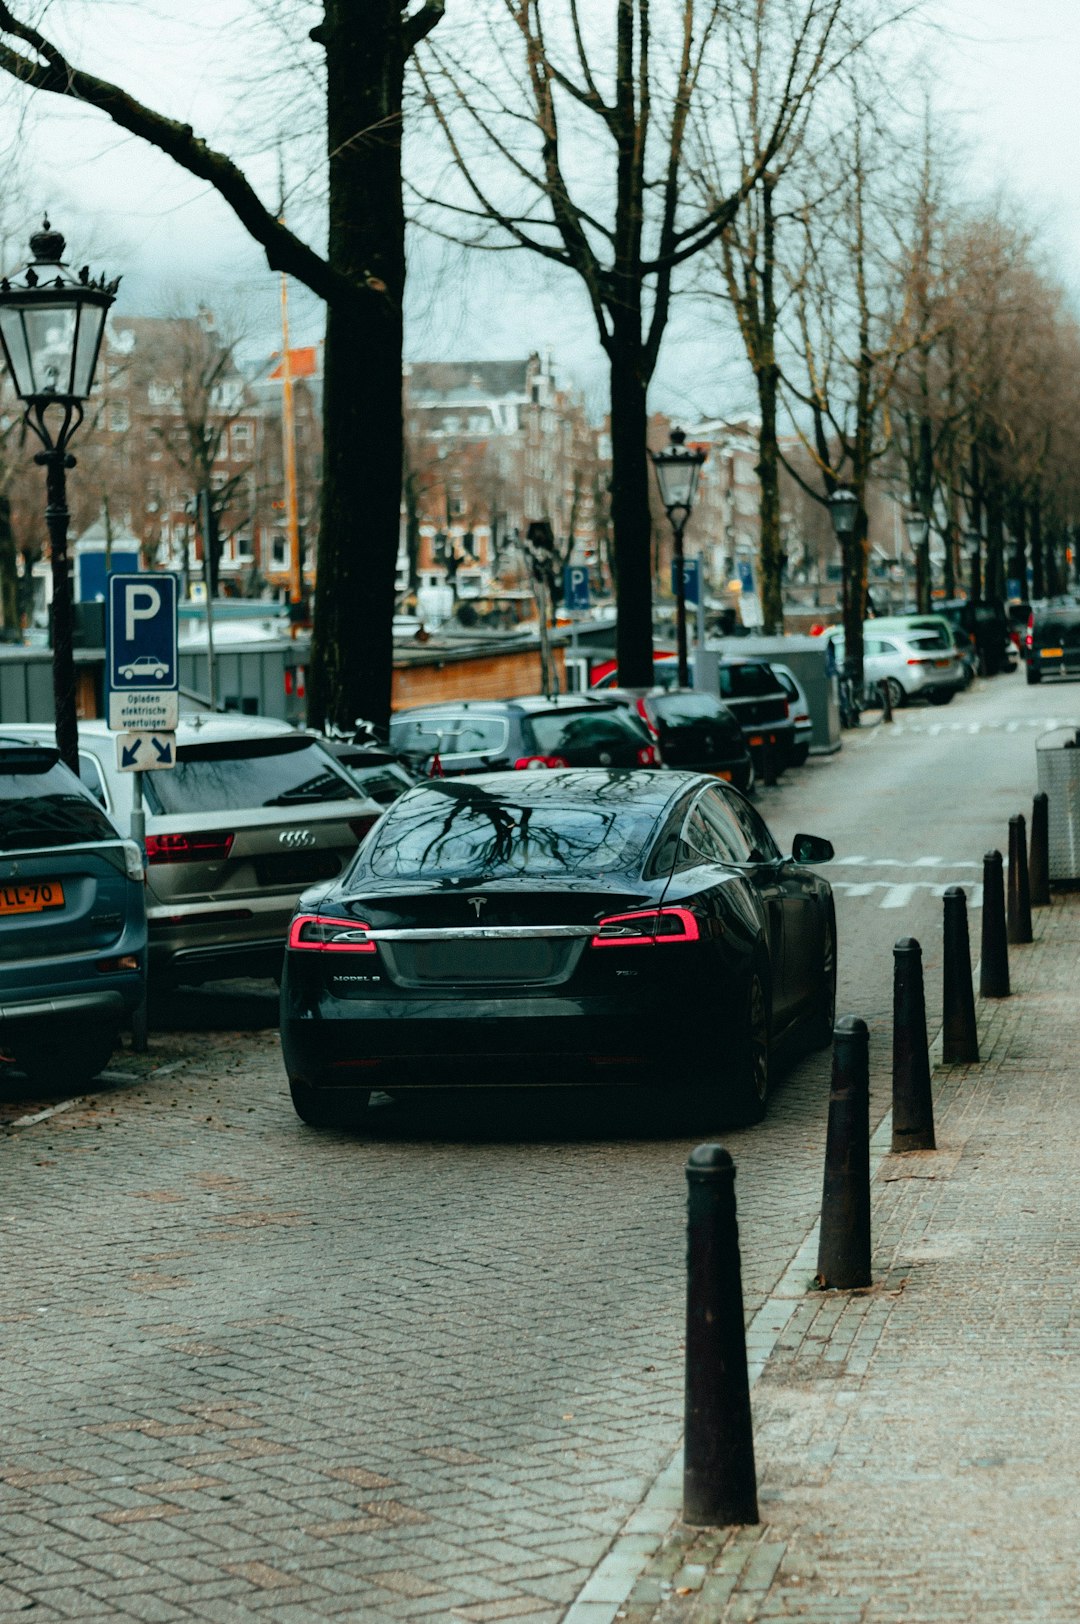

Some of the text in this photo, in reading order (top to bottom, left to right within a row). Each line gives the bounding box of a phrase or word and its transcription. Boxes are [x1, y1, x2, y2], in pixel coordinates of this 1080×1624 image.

[571, 570, 584, 592] P
[125, 584, 161, 641] P
[127, 694, 161, 705] Opladen
[121, 706, 167, 716] elektrische
[122, 719, 167, 730] voertuigen
[0, 885, 52, 906] LL-70
